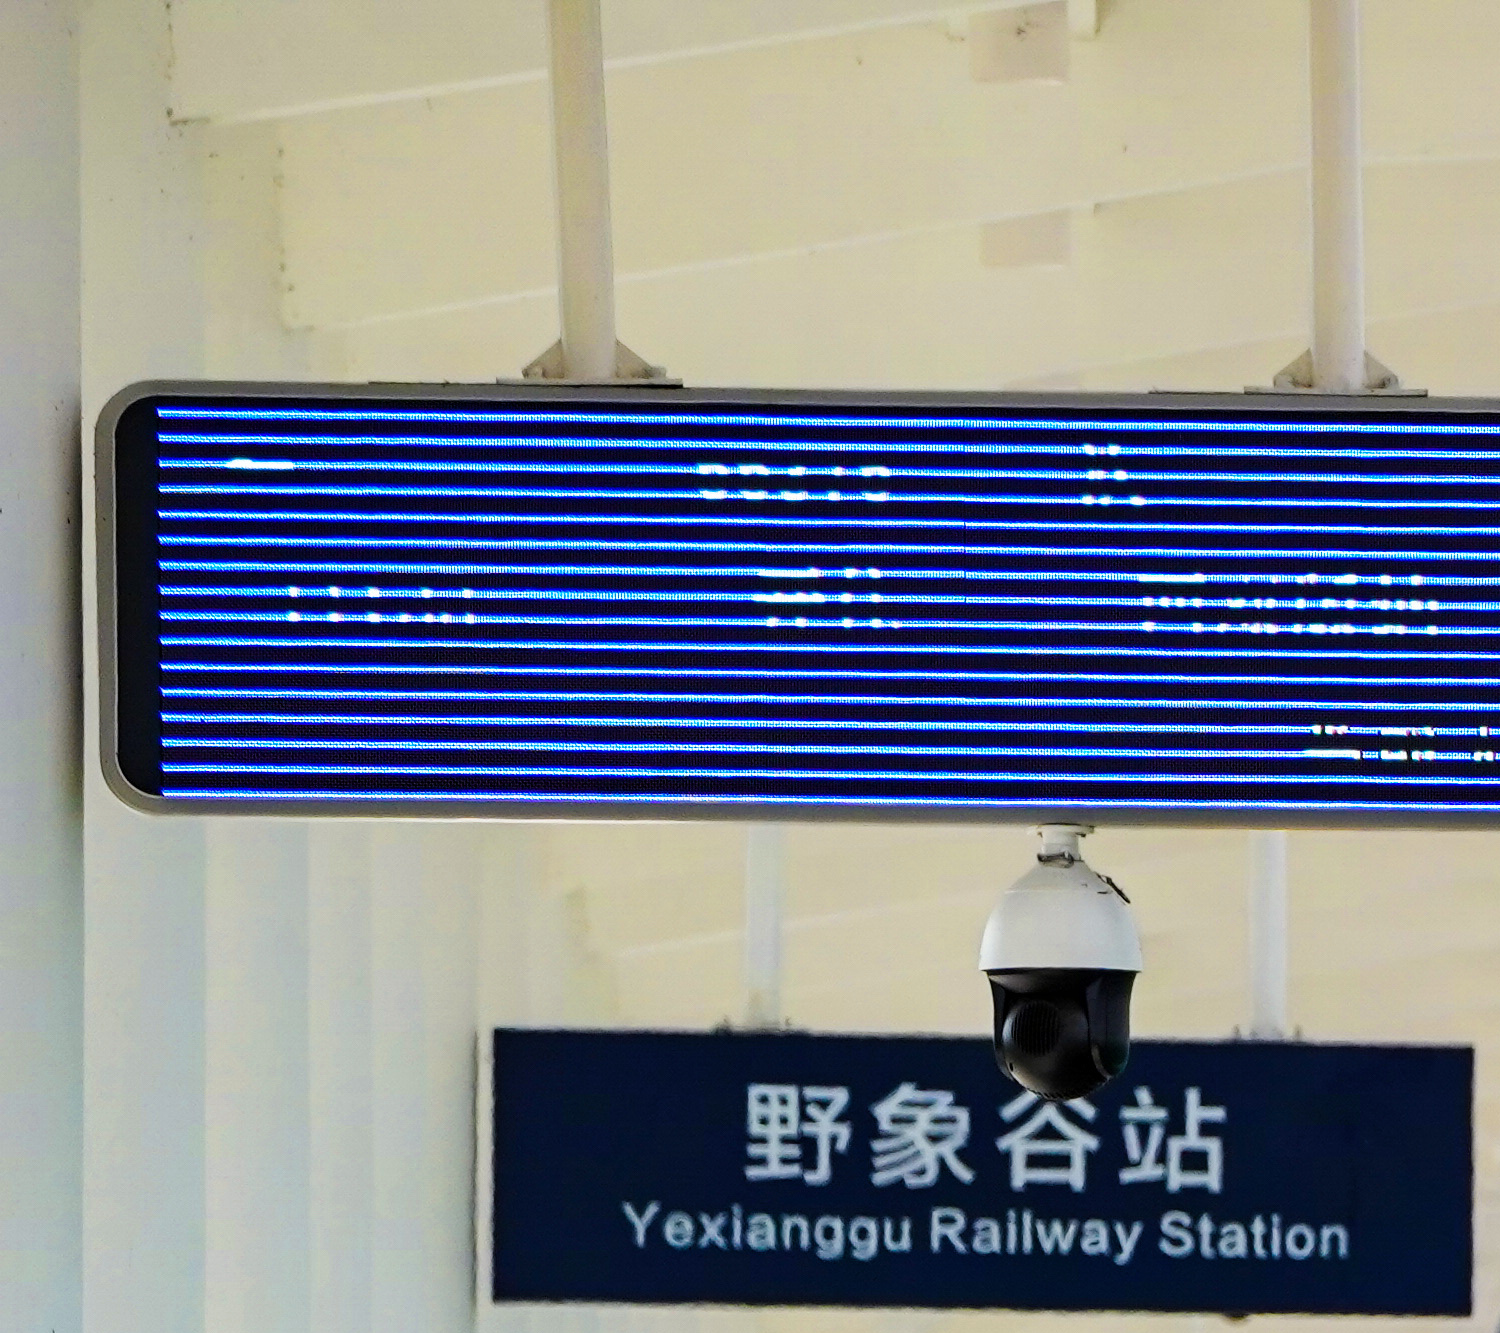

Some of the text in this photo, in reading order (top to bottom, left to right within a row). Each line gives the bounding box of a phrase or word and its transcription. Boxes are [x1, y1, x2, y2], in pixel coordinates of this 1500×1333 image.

[744, 1081, 1228, 1195] 野象谷站
[622, 1202, 1350, 1267] Yexianggu Railway Station
